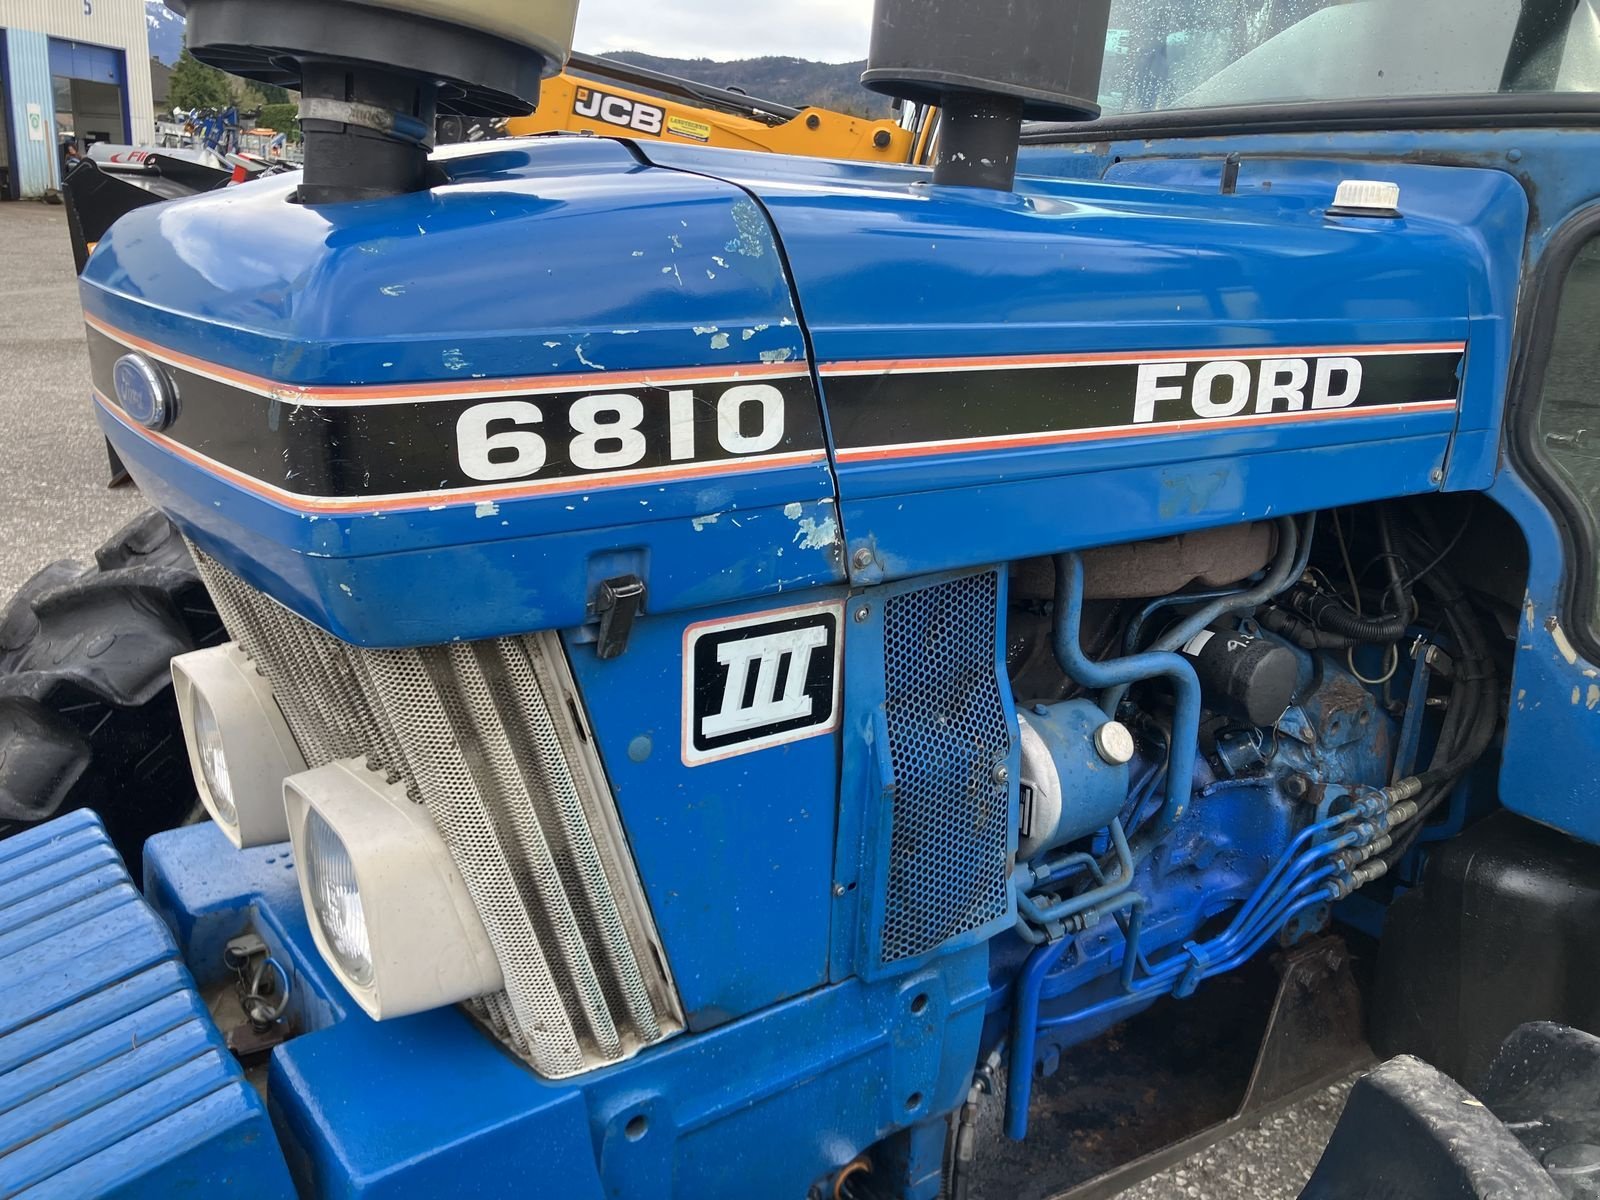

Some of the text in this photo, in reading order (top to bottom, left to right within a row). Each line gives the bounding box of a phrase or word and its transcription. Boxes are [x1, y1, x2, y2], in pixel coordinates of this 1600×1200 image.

[574, 92, 663, 134] JCB
[1133, 357, 1363, 424] FORD
[456, 384, 785, 481] 6810
[702, 625, 828, 739] III
